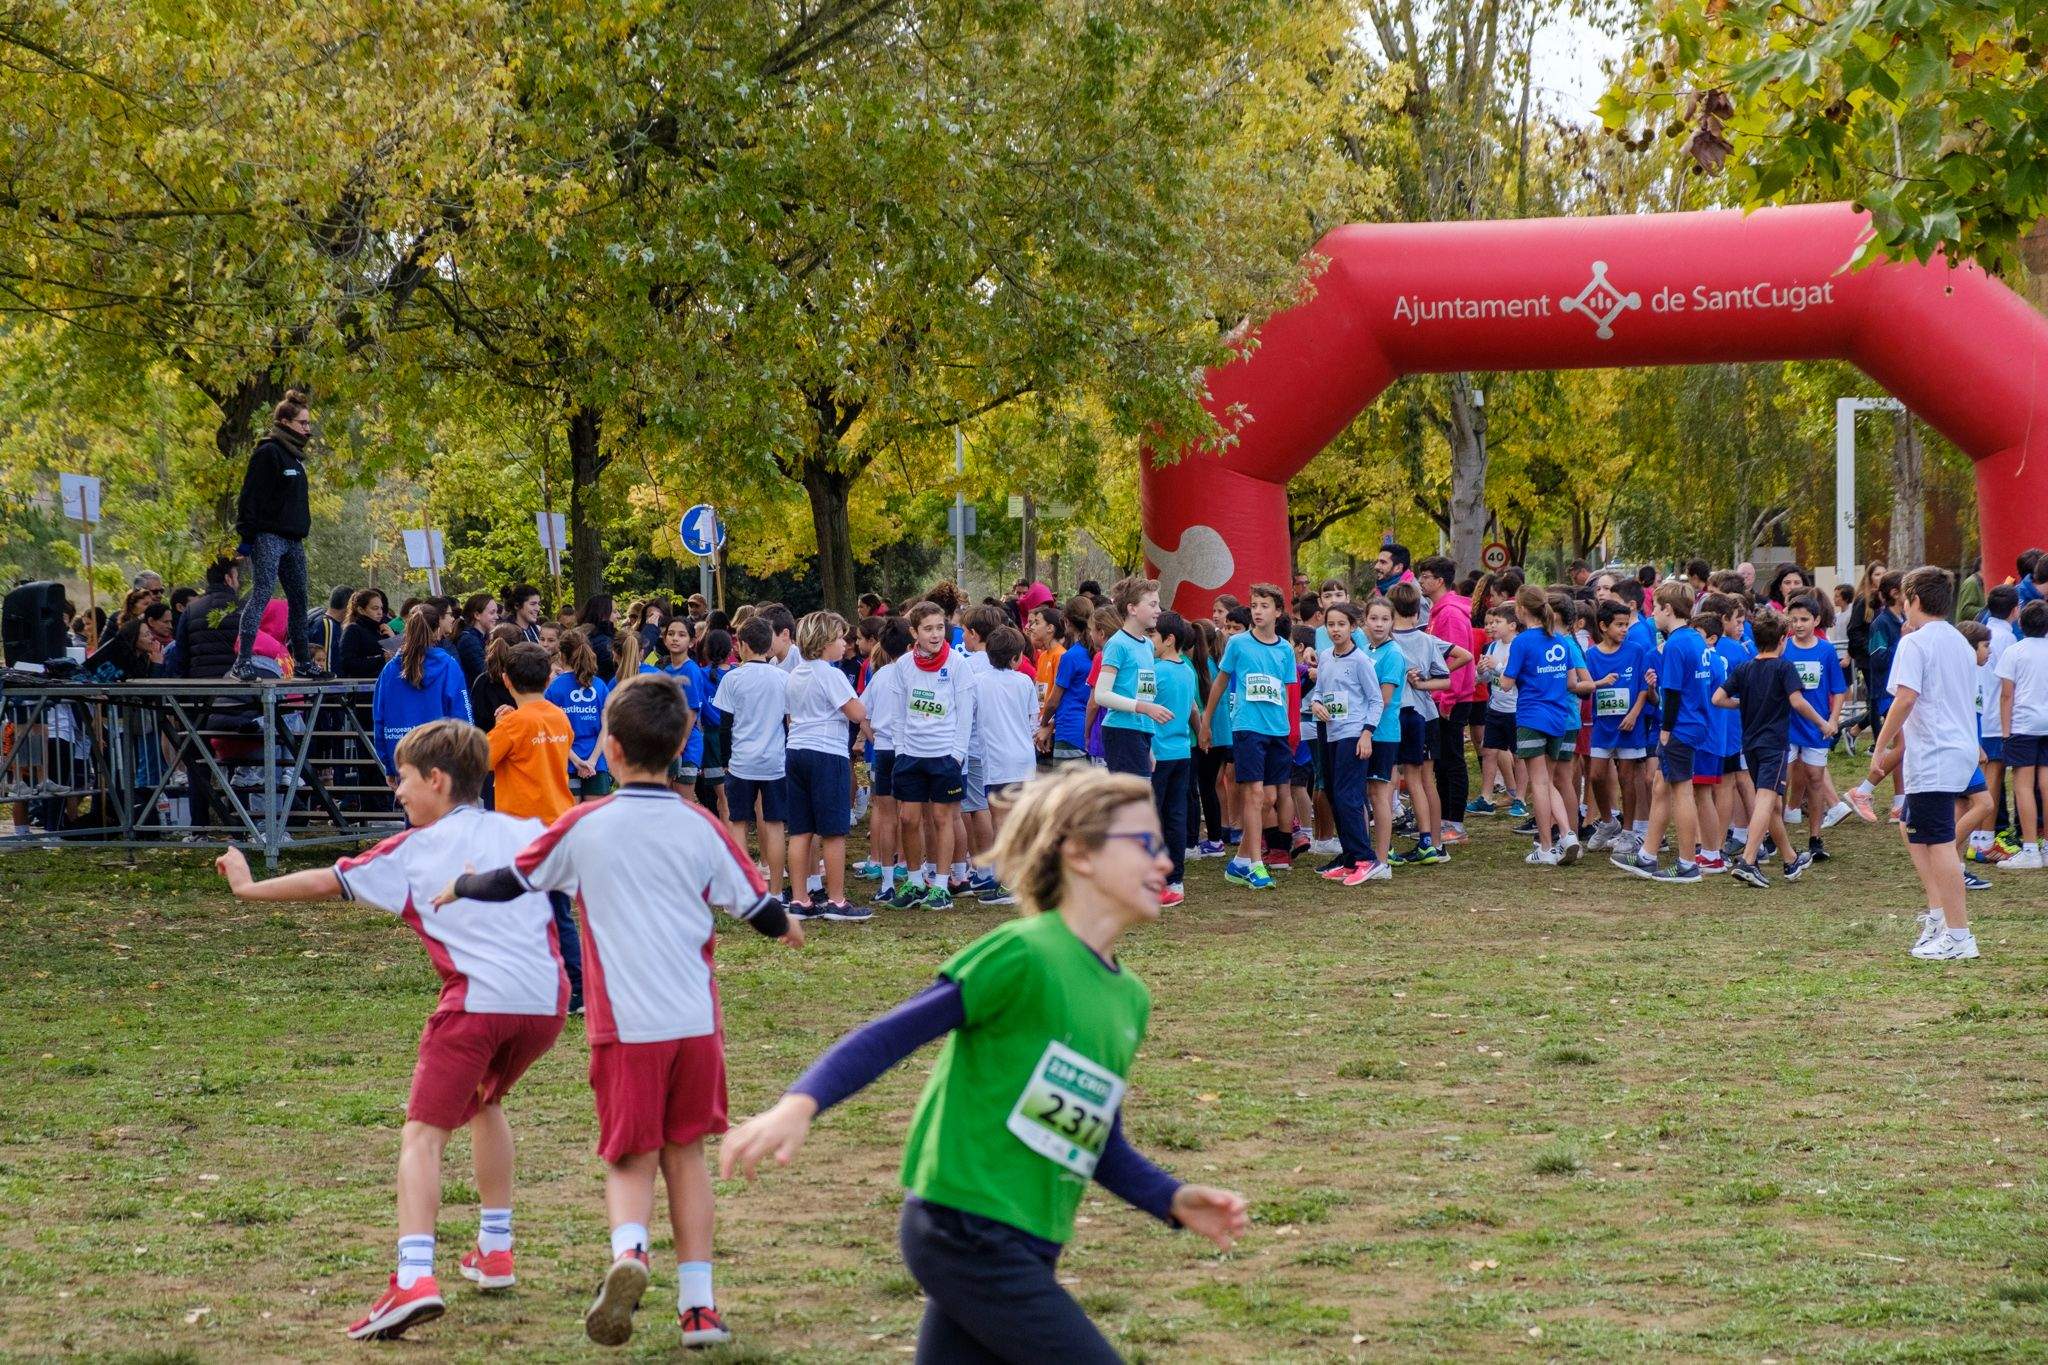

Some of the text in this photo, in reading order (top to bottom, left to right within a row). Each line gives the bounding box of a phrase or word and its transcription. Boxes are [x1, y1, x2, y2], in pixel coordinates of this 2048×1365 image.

[1393, 282, 1834, 326] Ajuntament de SantCugat
[1488, 552, 1504, 561] 40
[914, 700, 942, 713] 4759
[1327, 703, 1343, 713] 82
[1600, 699, 1625, 709] 3438
[561, 705, 597, 714] nstitució
